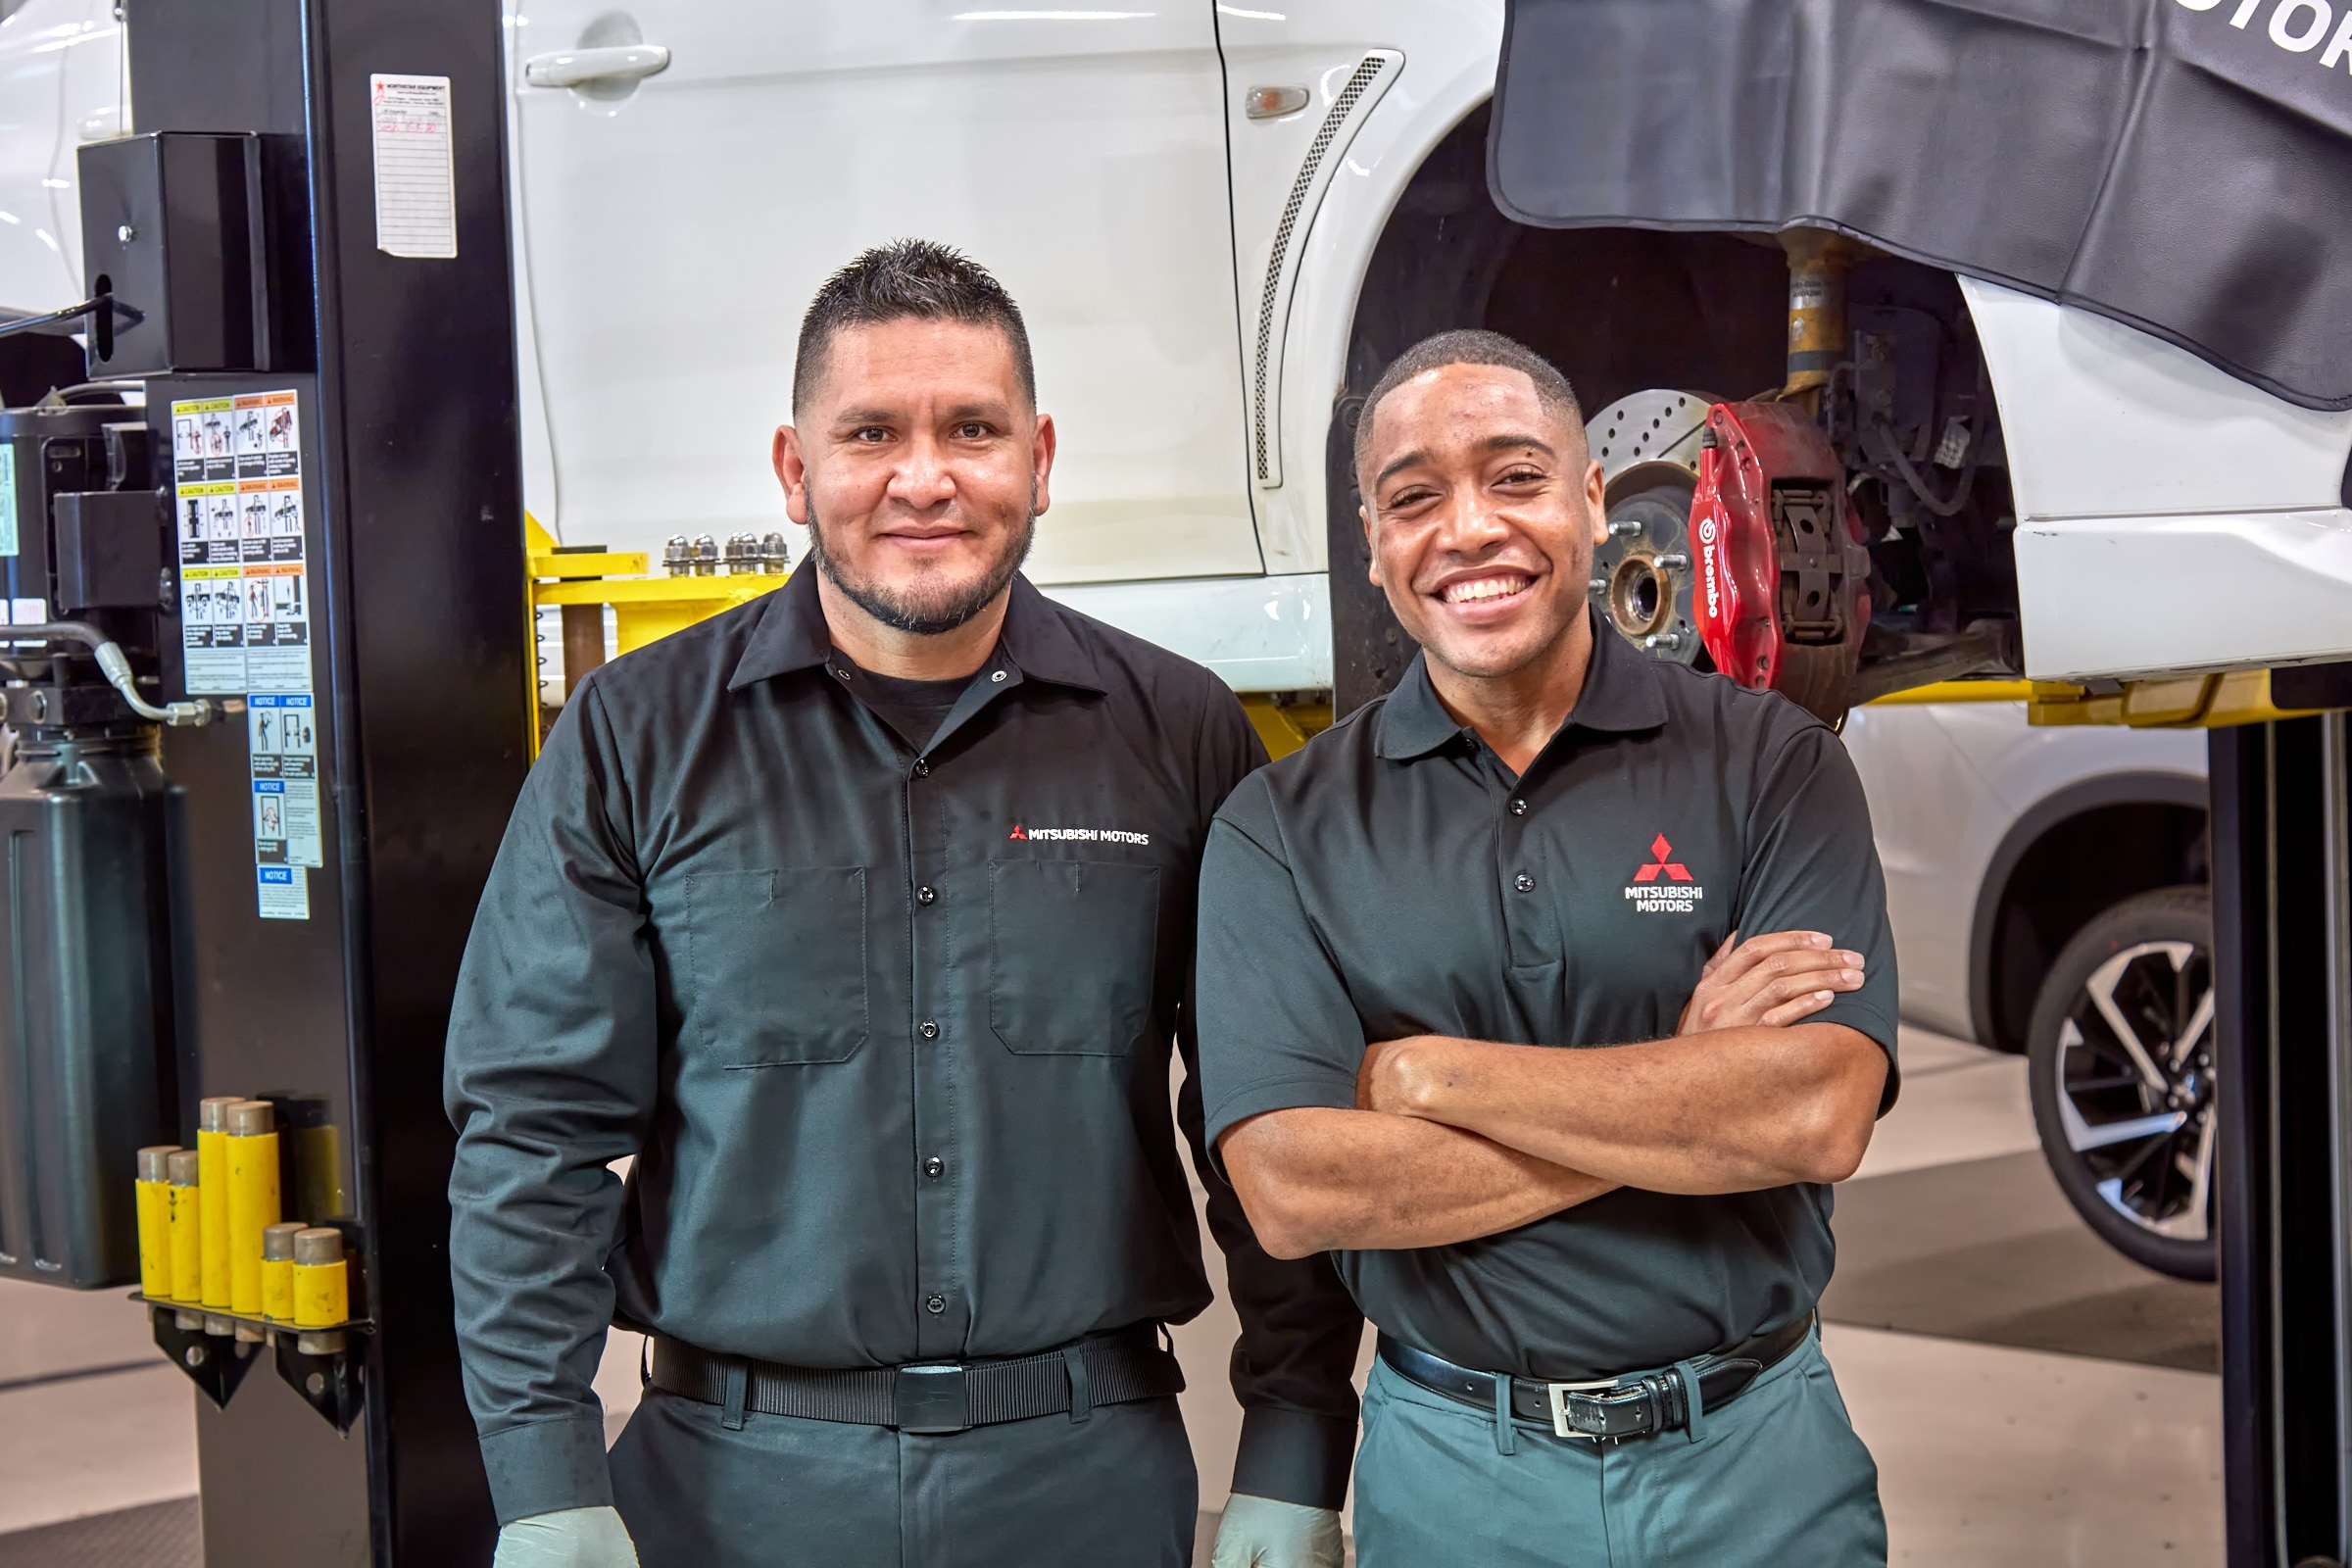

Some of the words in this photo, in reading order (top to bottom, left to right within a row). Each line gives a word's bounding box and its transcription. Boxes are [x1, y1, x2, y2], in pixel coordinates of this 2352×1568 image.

[1703, 545, 1719, 618] brembo
[255, 697, 275, 706] NOTICE
[259, 782, 280, 791] NOTICE
[1028, 829, 1098, 841] MITSUBISHI
[1100, 831, 1150, 845] MOTORS
[265, 870, 287, 881] NOTICE
[1625, 886, 1703, 900] MITSUBISHI
[1636, 900, 1694, 912] MOTORS
